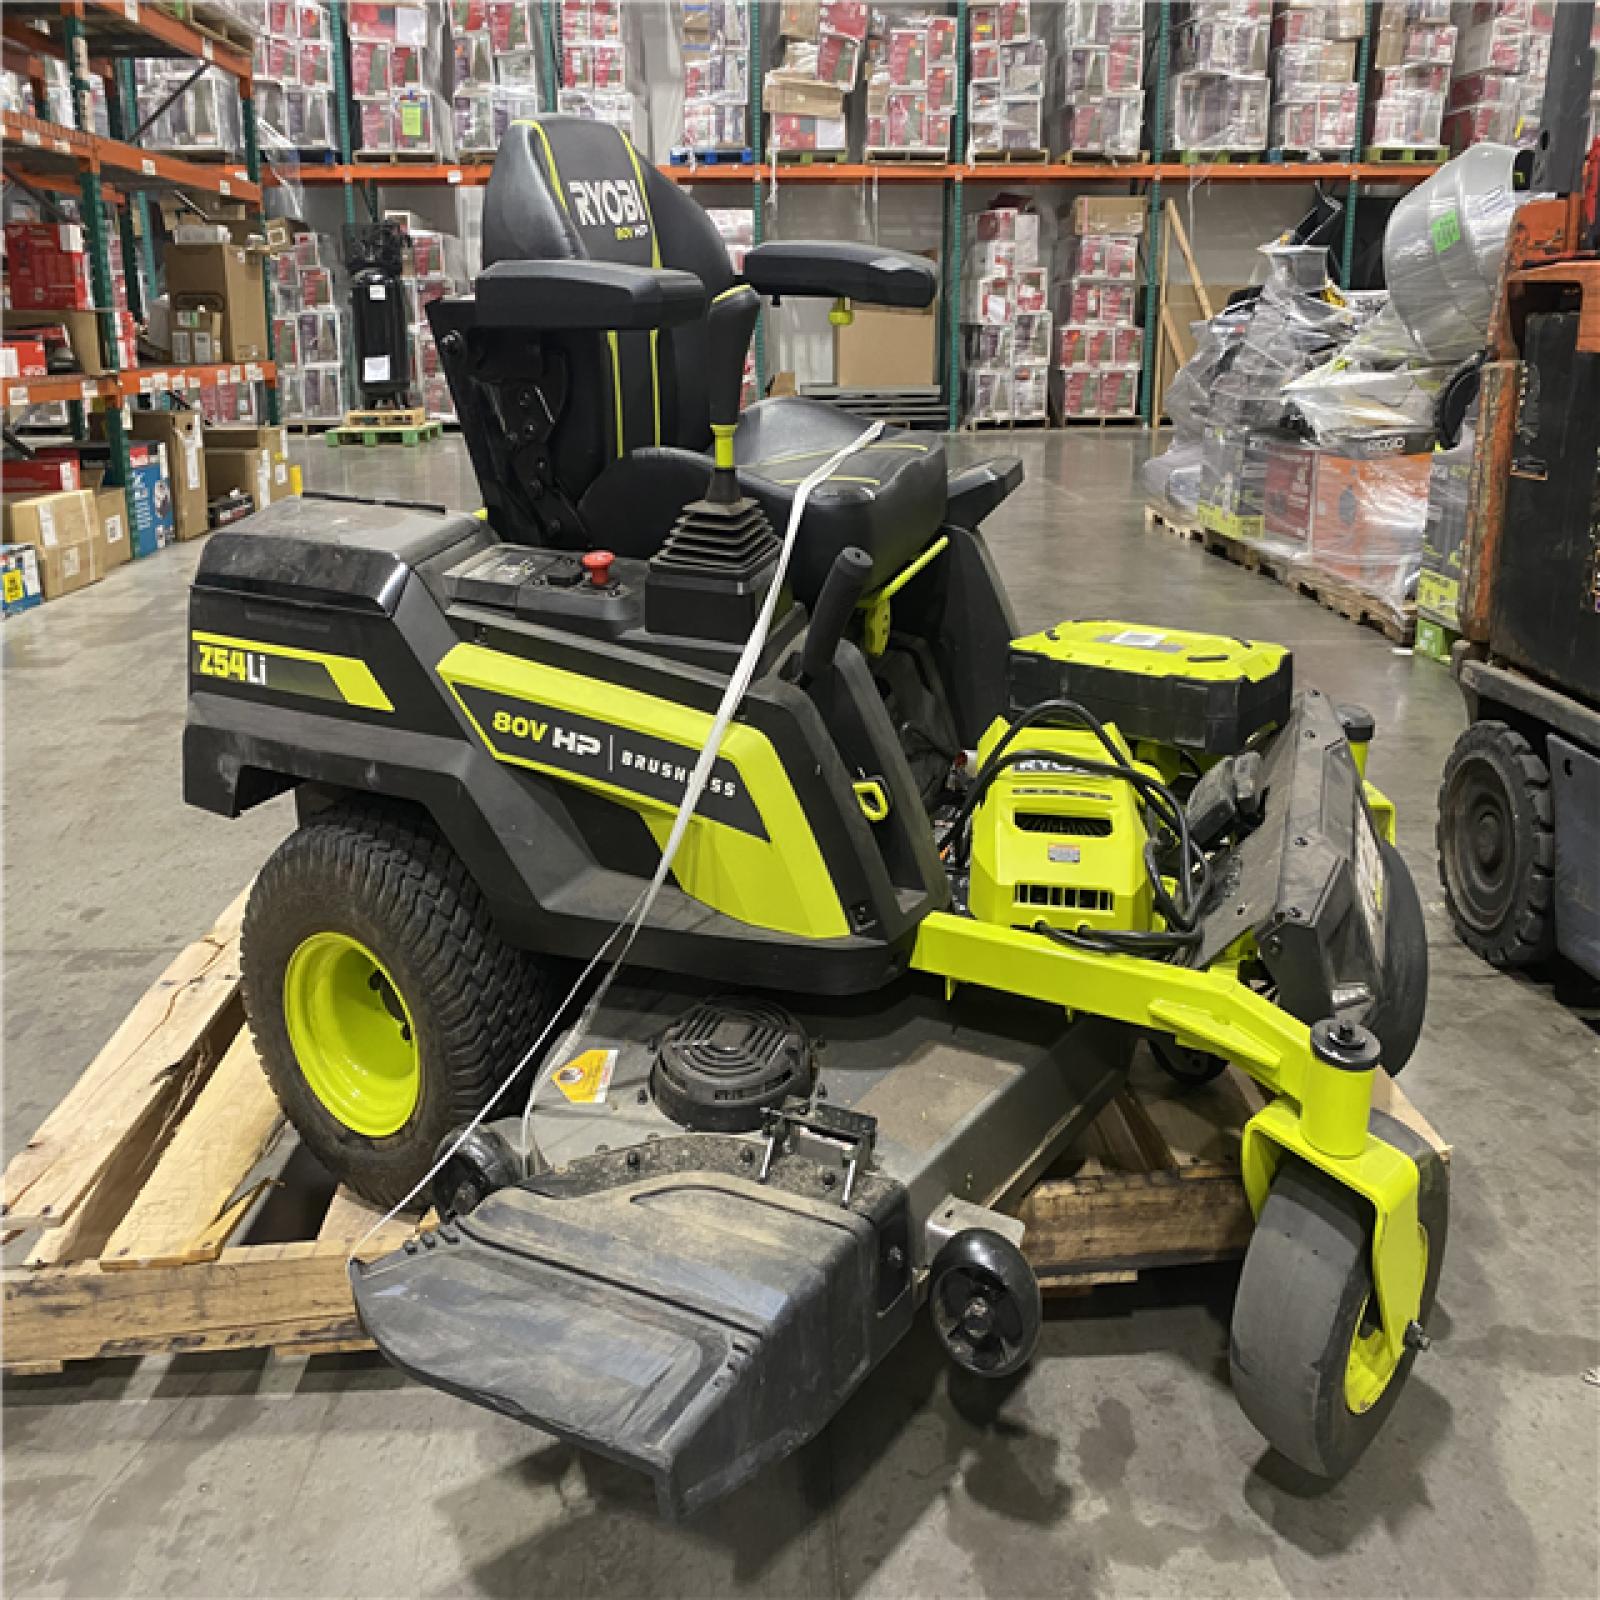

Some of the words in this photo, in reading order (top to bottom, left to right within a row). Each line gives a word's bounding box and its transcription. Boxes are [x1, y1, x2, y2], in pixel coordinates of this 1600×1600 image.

[568, 179, 646, 226] RYOBI
[198, 644, 267, 686] Z54Li
[492, 710, 549, 743] 80V
[551, 726, 603, 756] HP
[621, 749, 736, 798] BRUSHSS
